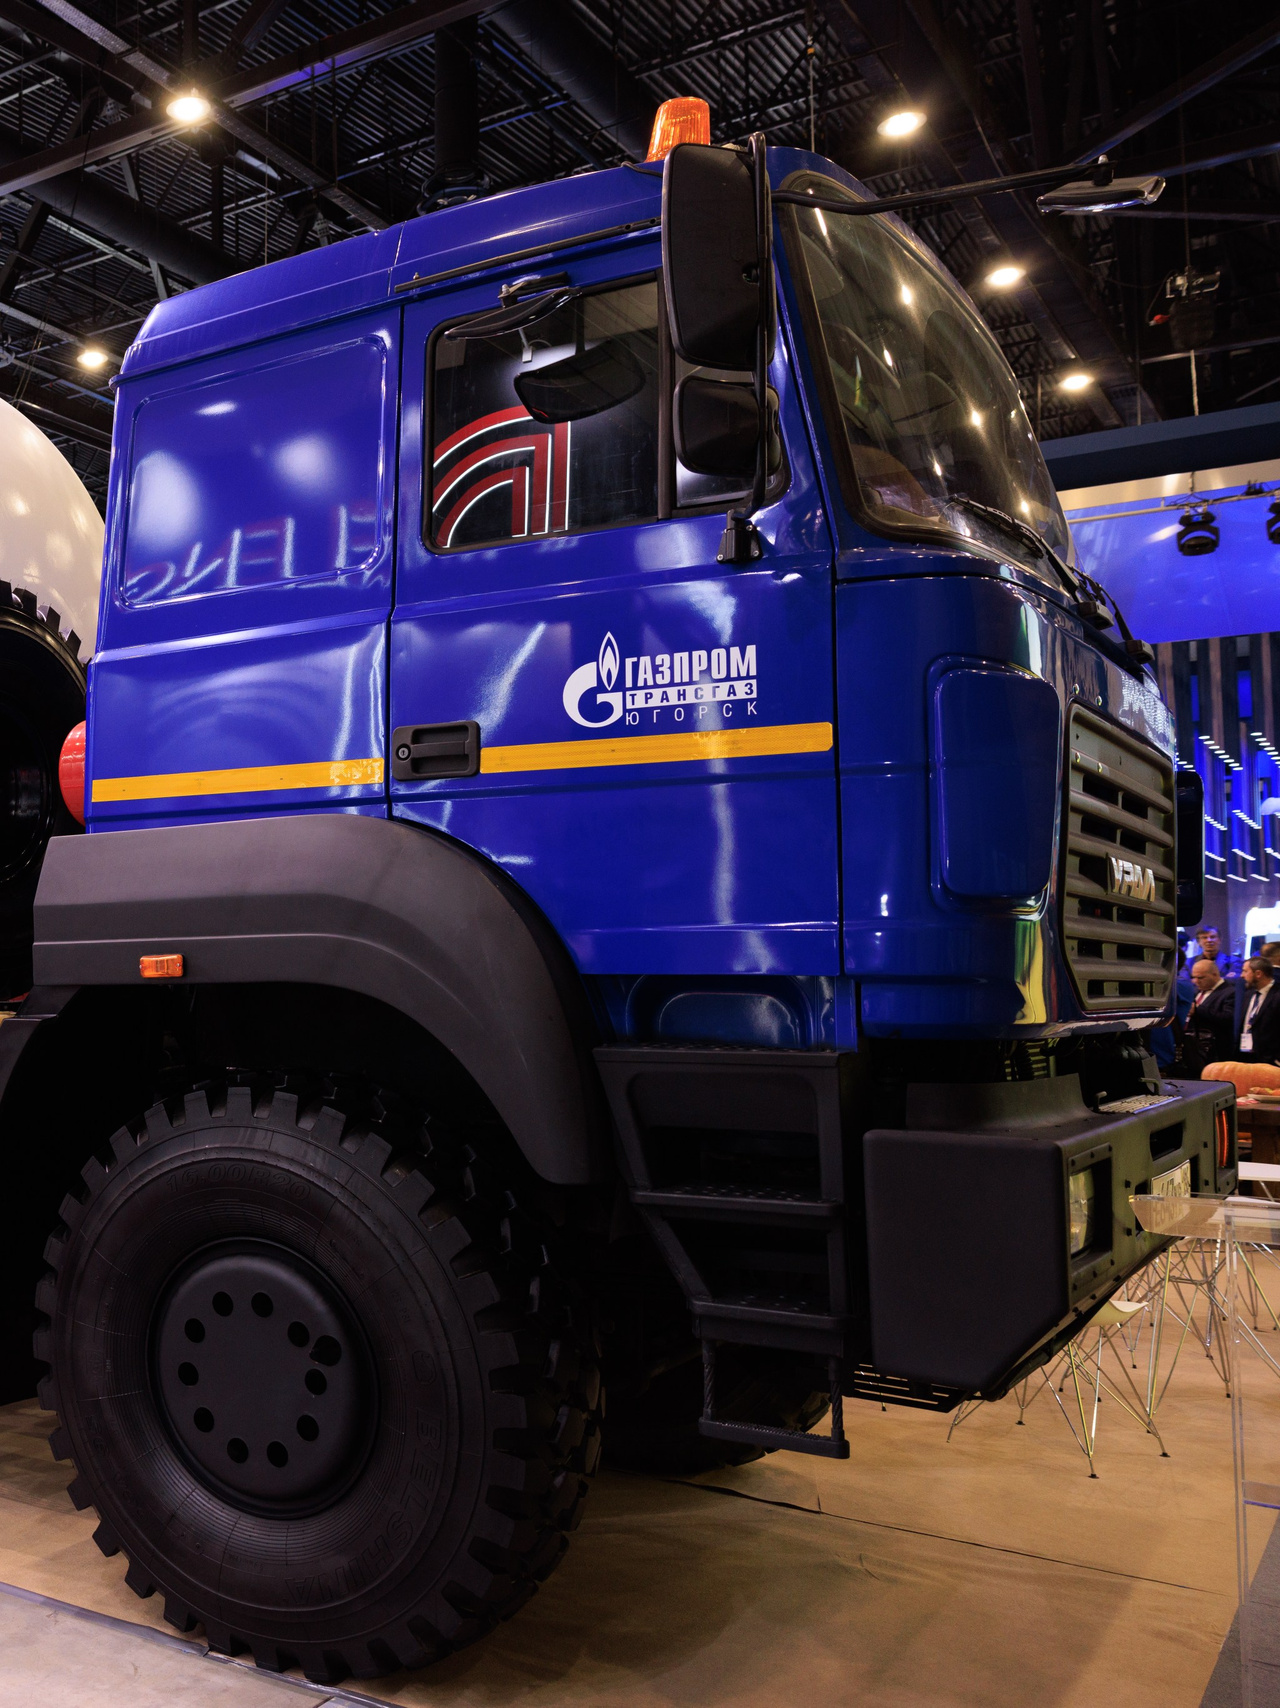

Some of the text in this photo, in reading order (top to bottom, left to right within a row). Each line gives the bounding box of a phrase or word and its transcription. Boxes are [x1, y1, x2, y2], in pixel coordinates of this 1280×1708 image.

[625, 644, 757, 688] ГАЗПРОМ
[625, 701, 757, 726] ЮГОРСК
[628, 682, 755, 706] ТРАНСГАЗ
[166, 1162, 312, 1201] 16.00R20
[284, 1407, 443, 1606] BELSHINA
